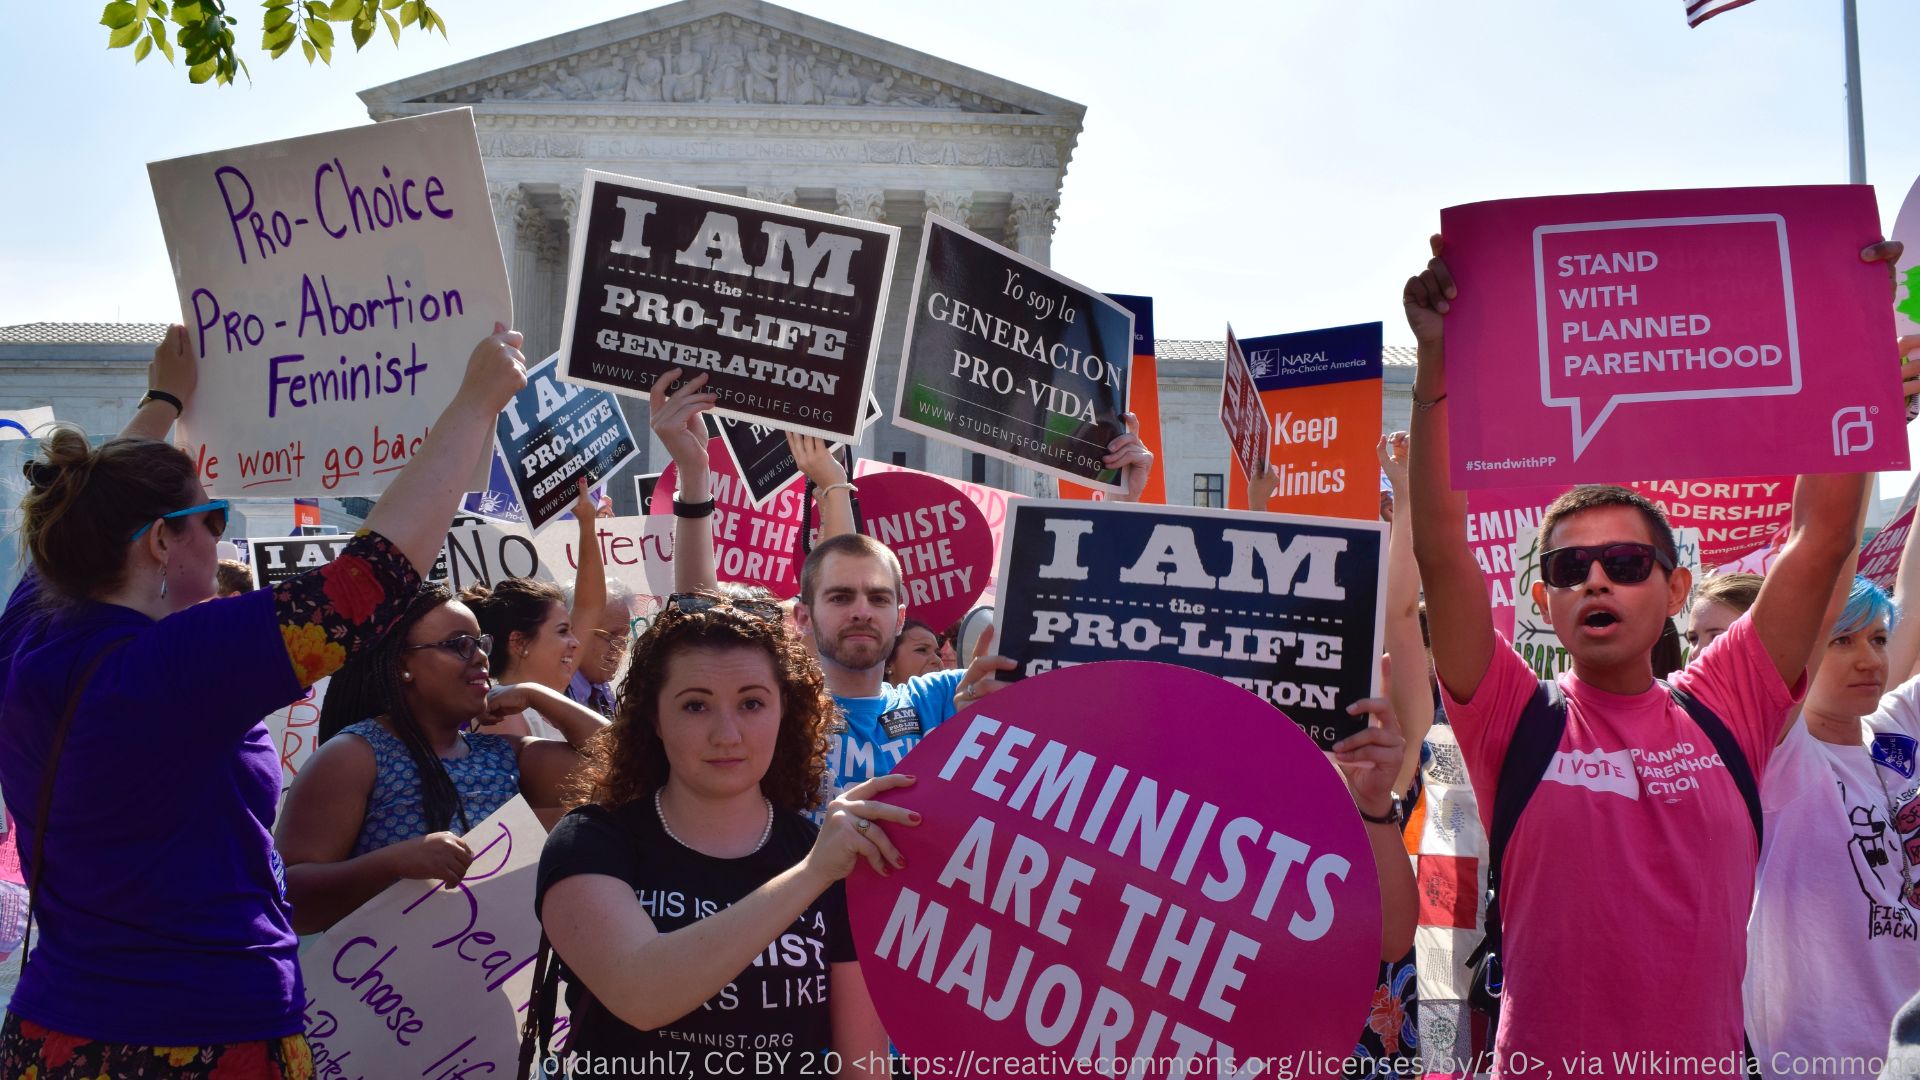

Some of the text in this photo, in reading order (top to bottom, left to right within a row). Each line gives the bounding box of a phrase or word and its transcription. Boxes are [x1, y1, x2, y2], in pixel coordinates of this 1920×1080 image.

[610, 196, 862, 296] I AM
[1557, 250, 1659, 277] STAND
[712, 280, 742, 298] the
[1002, 268, 1076, 325] Yo soy la
[1558, 284, 1638, 310] WITH
[600, 284, 847, 360] PRO-LIFE
[1562, 315, 1711, 344] PLANNED
[927, 292, 1124, 390] GENERACION
[1282, 351, 1328, 366] NARAL
[596, 329, 840, 395] GENERATION
[1282, 358, 1366, 375] Pro-Choice America
[1564, 345, 1783, 377] PARENTHOOD
[269, 342, 428, 418] Feminist
[950, 350, 1099, 426] PRO-VIDA
[501, 397, 529, 441] I
[558, 414, 570, 425] the
[1275, 411, 1338, 448] Keep
[521, 400, 613, 478] PRO-LIFE
[238, 441, 305, 478] won't
[322, 445, 364, 489] go
[532, 424, 620, 499] GENERATION
[1465, 456, 1557, 472] #StandwithPP
[867, 500, 967, 546] INISTS
[1654, 500, 1792, 521] ADERSHIP
[711, 508, 800, 554] RE THE
[264, 546, 286, 569] I
[566, 528, 675, 572] uteru
[898, 538, 955, 575] THE
[1038, 518, 1348, 600] I AM
[1169, 599, 1206, 616] the
[1029, 610, 1343, 669] PRO-LIFE
[894, 708, 916, 719] AM
[1558, 756, 1626, 779] I VOTE
[1647, 776, 1700, 796] CTION
[938, 714, 1351, 941] FEMINISTS
[937, 816, 1262, 1023] ARE THE
[1874, 921, 1912, 939] BACK
[332, 936, 423, 1046] Choose
[762, 974, 826, 1009] LIKE
[658, 1029, 794, 1051] FEMINIST.ORG
